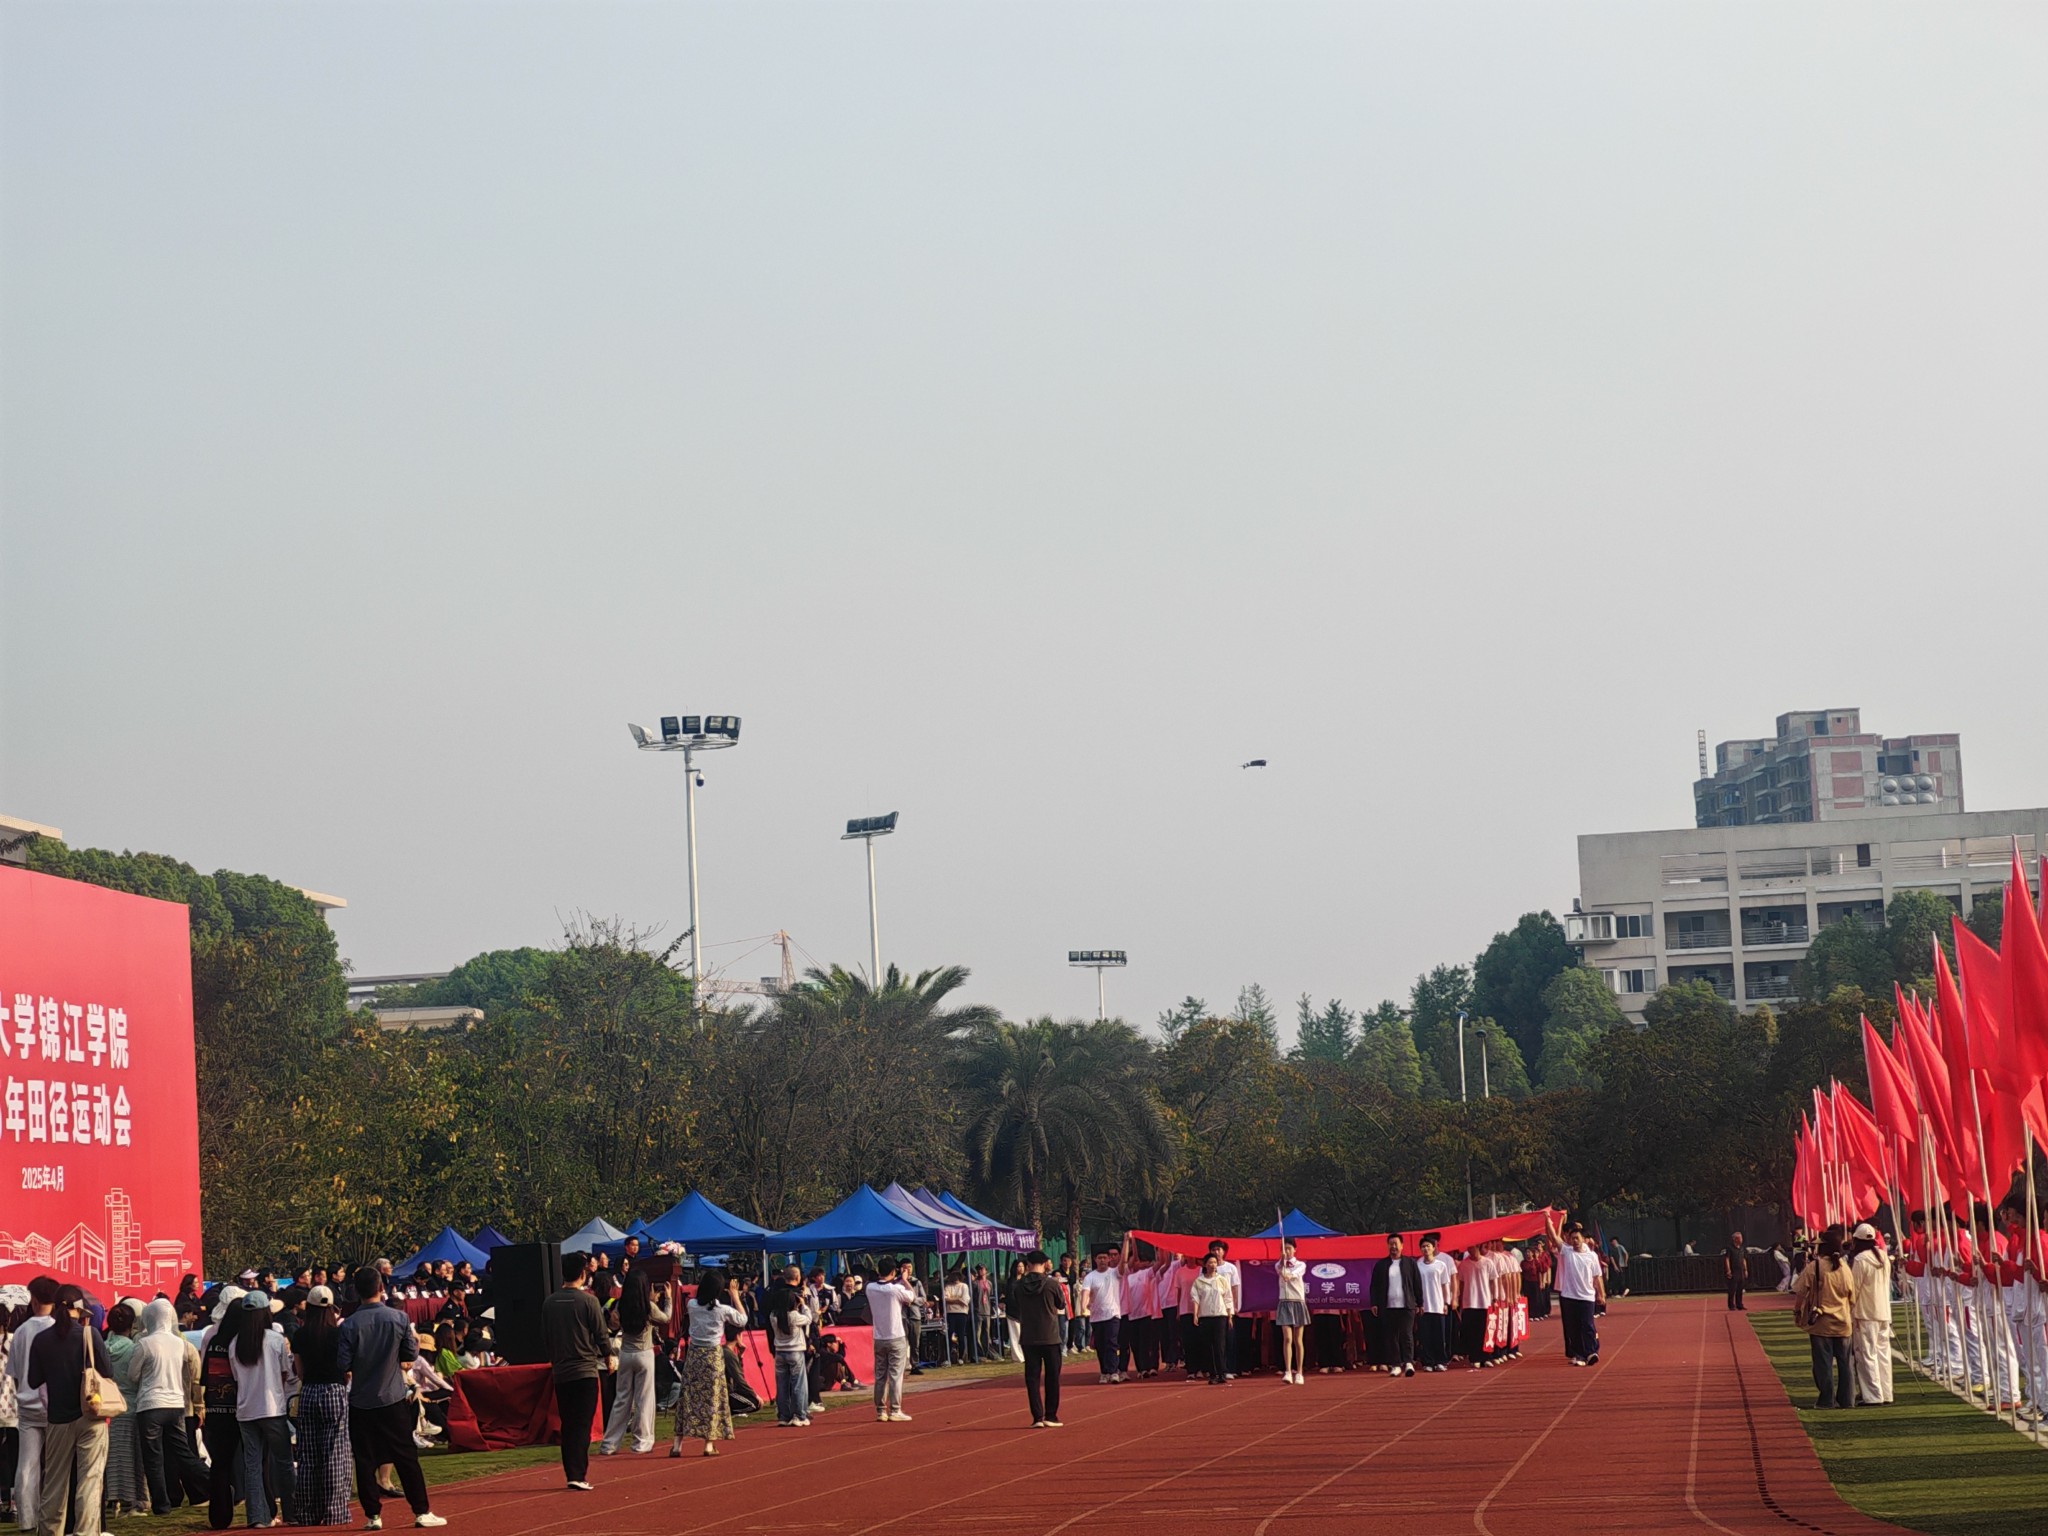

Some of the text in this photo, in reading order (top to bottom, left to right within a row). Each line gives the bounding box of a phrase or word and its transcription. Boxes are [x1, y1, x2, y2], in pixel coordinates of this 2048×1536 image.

[0, 1075, 131, 1147] 年田径运动会
[22, 1165, 64, 1192] 2025年4月
[1329, 1296, 1360, 1304] Business
